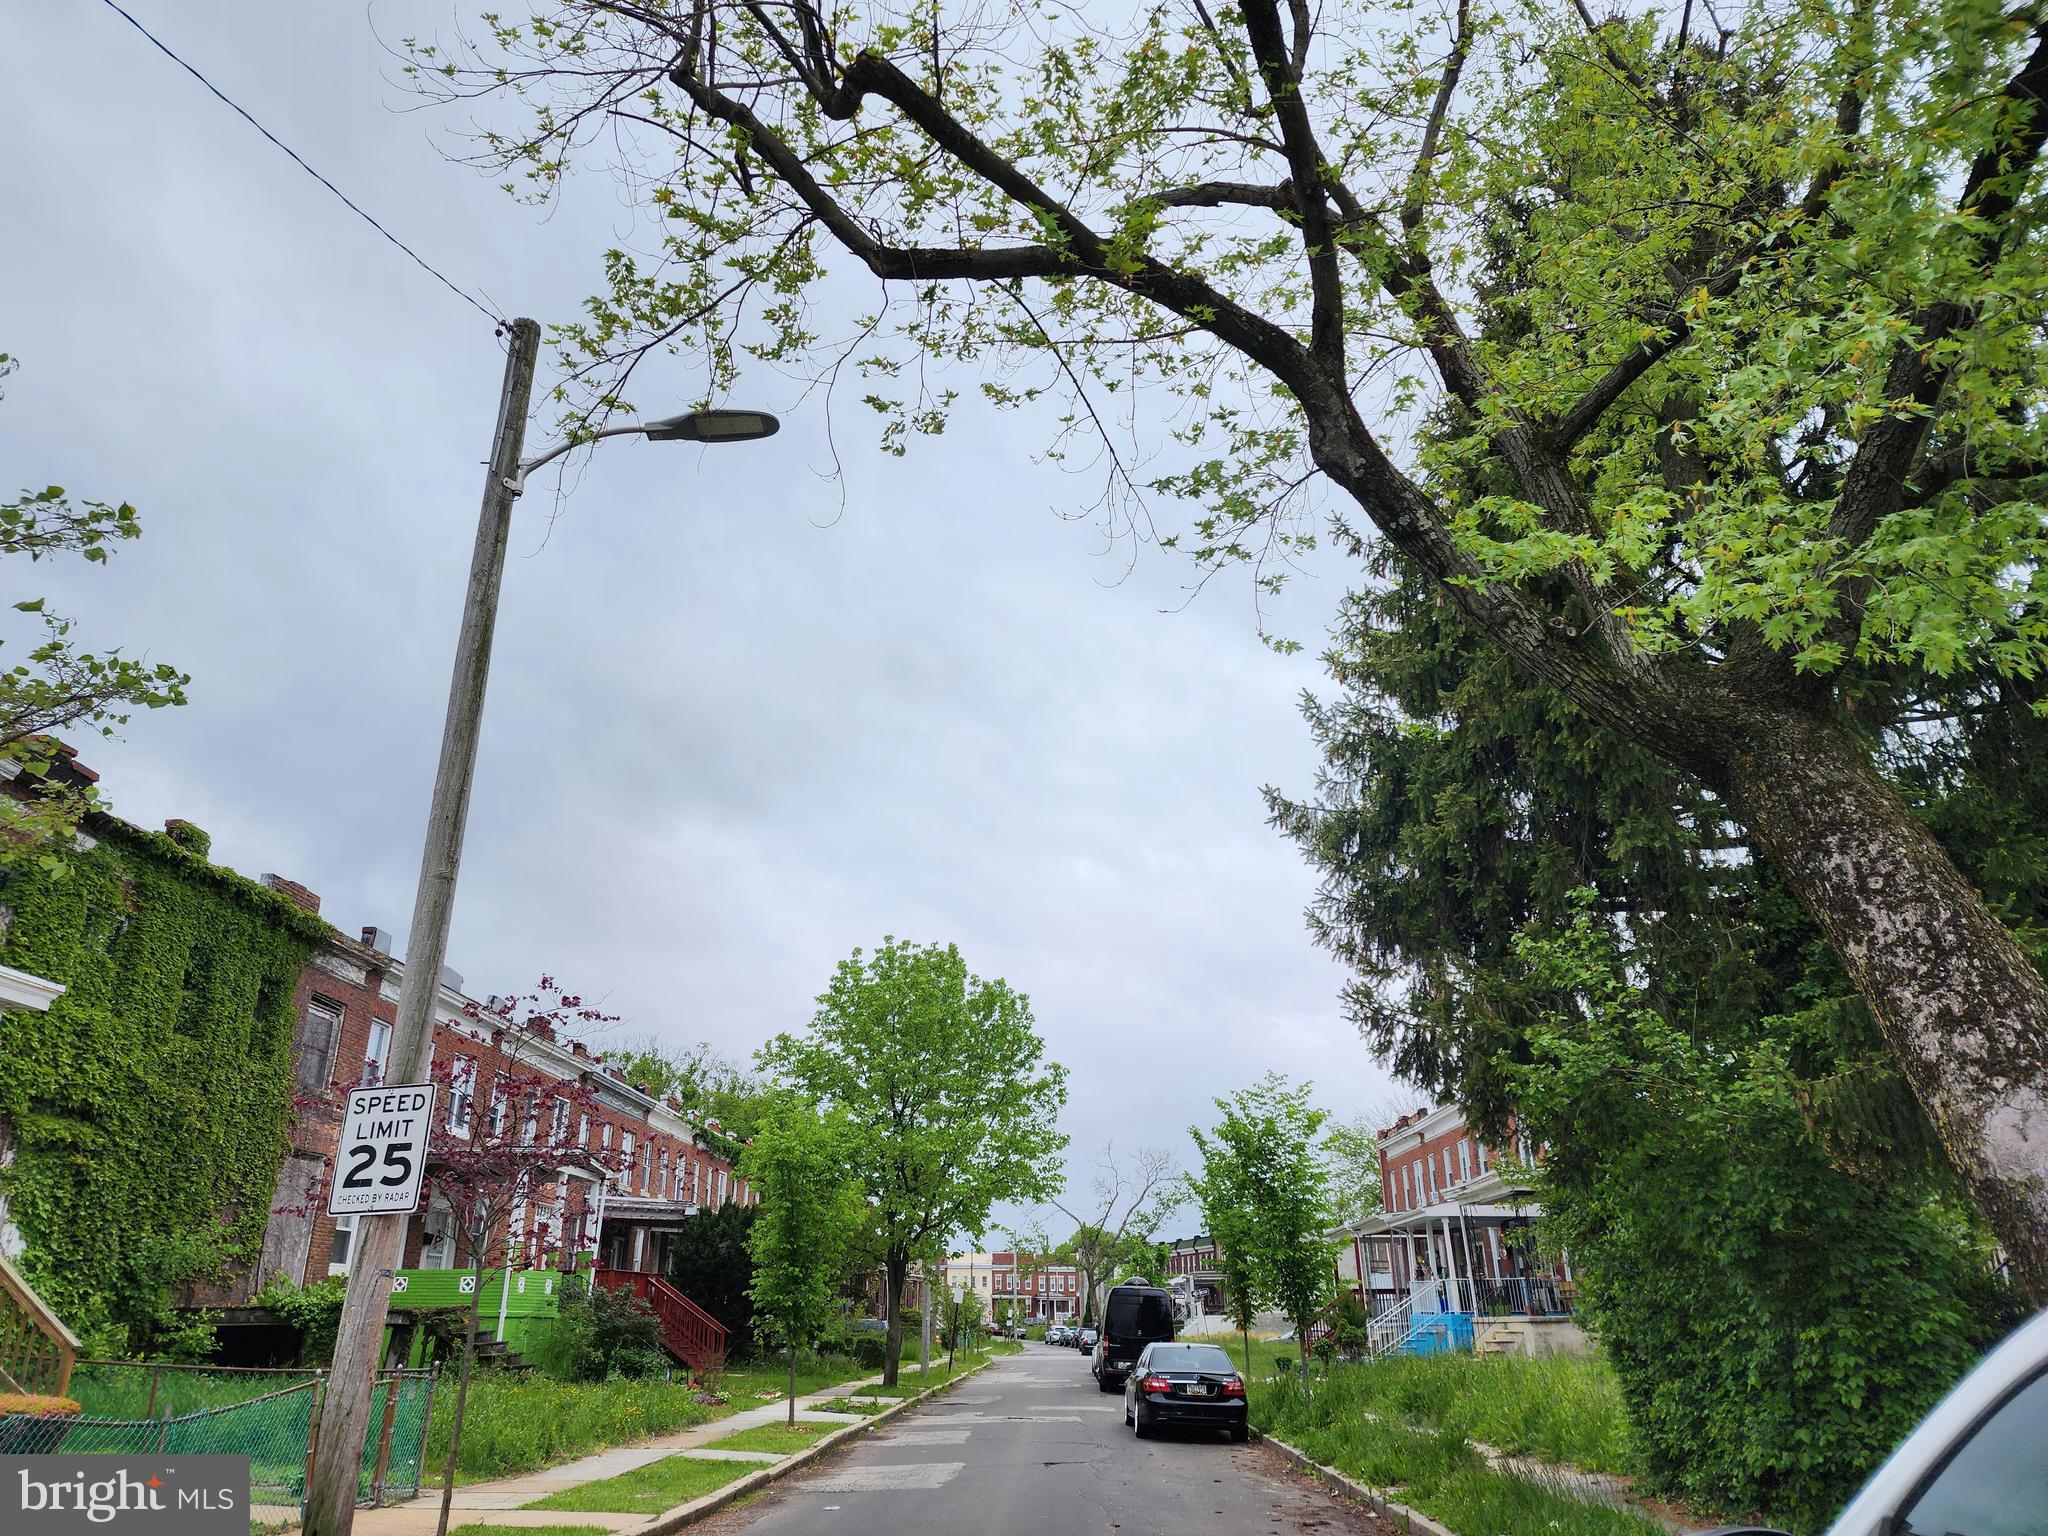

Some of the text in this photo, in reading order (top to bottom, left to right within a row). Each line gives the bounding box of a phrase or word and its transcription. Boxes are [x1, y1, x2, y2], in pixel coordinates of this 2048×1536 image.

[353, 1094, 426, 1115] SPEED
[356, 1119, 414, 1140] LIMIT
[342, 1142, 413, 1189] 25
[337, 1191, 410, 1205] CHECKED BY RADAR
